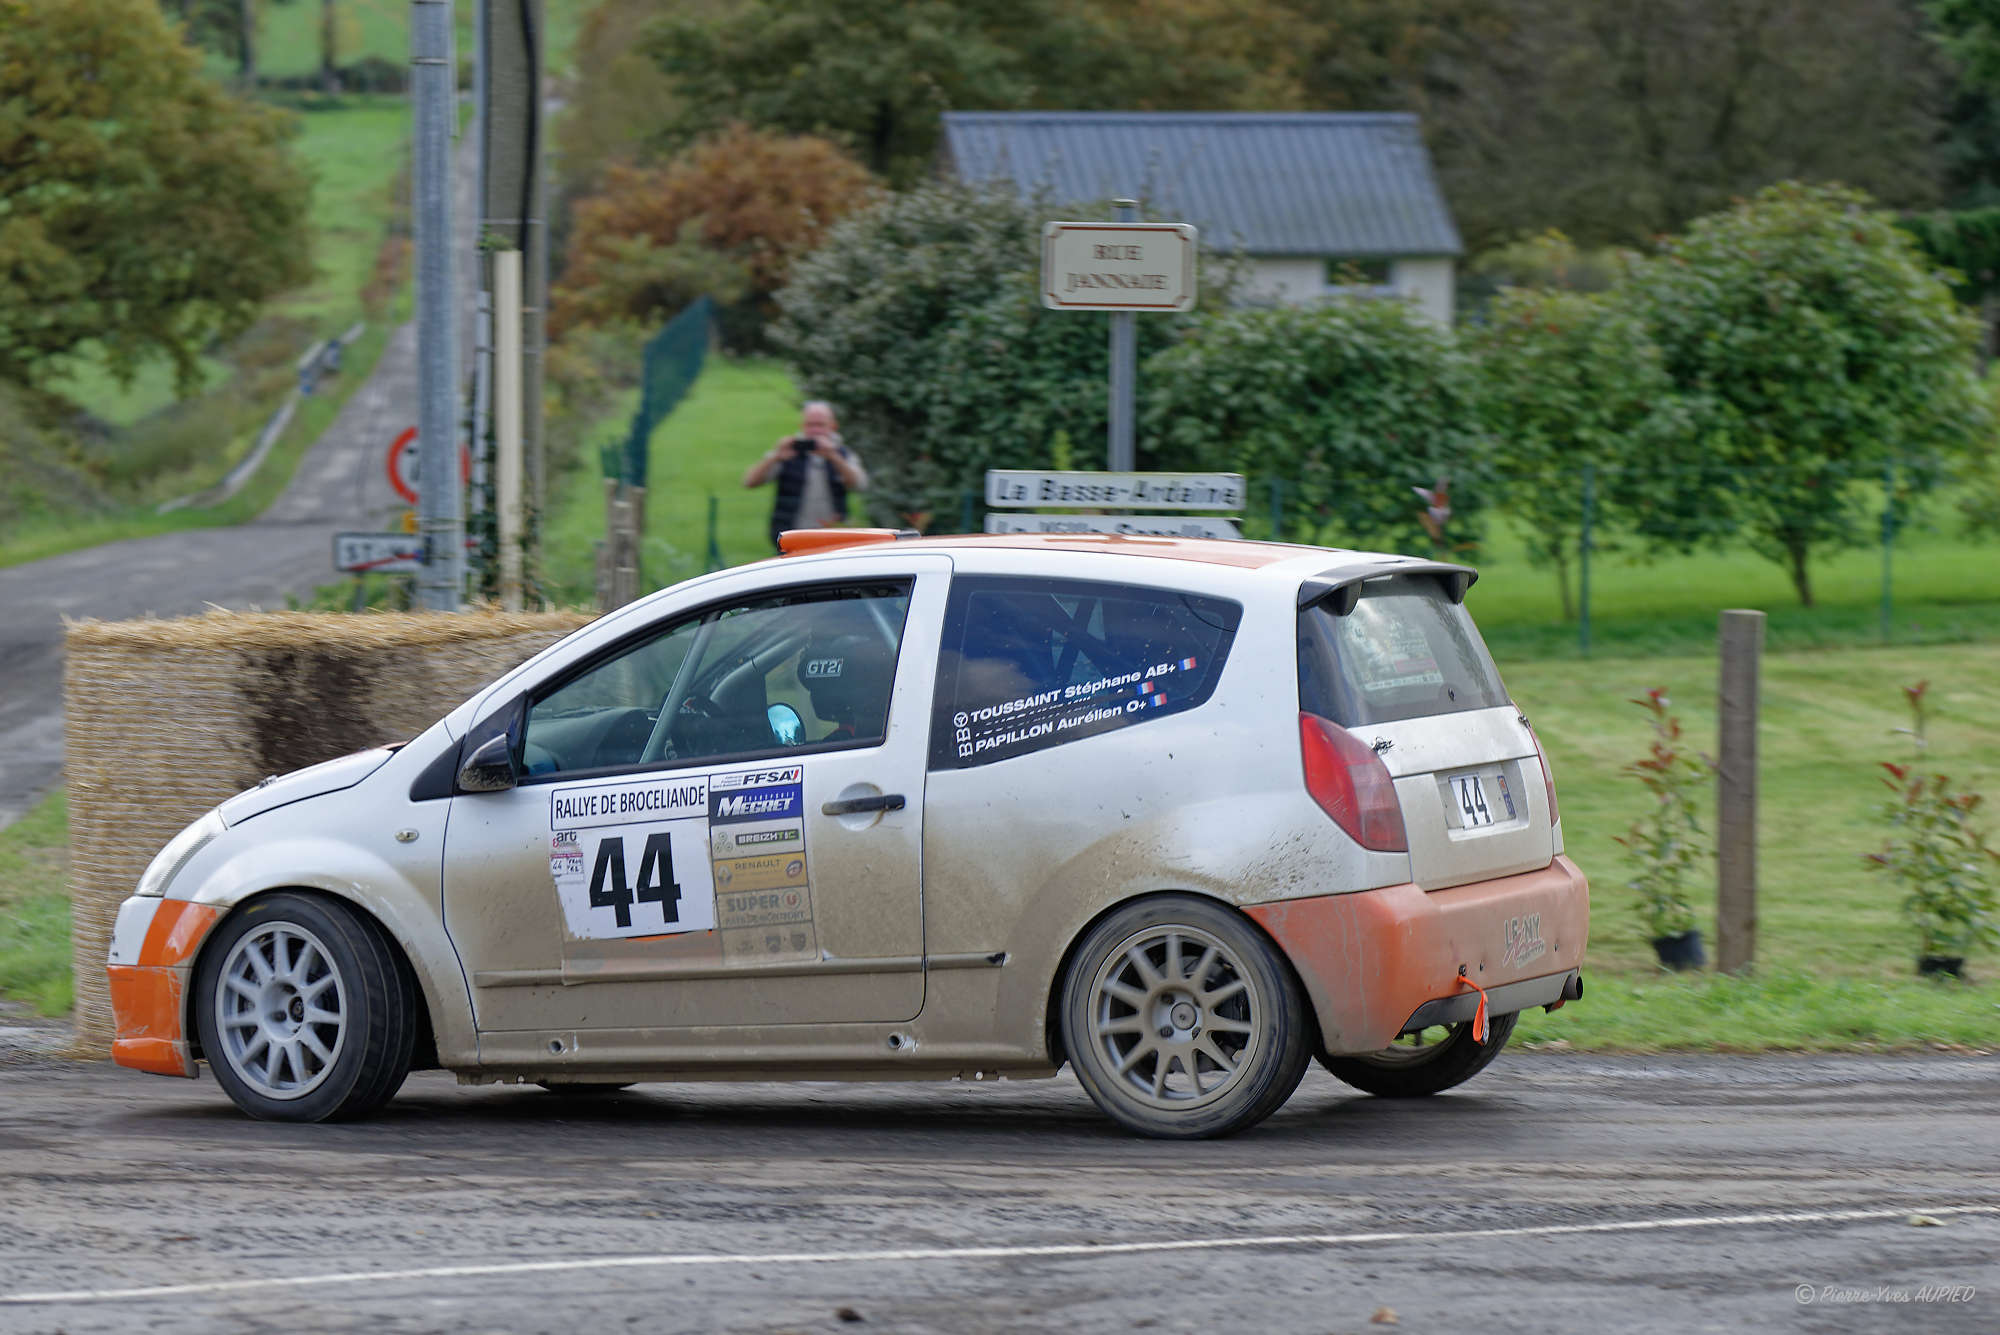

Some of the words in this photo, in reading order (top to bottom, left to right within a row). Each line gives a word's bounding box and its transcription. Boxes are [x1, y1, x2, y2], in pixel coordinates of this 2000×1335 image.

[1094, 244, 1144, 260] RUE
[997, 478, 1027, 501] La
[971, 688, 1061, 723] TOUSSAINT
[1064, 670, 1141, 700] Stéphane
[1144, 662, 1176, 680] AB+
[975, 720, 1053, 752] PAPILLON
[1056, 705, 1123, 731] Aurélien
[743, 770, 794, 785] FFSA
[555, 795, 598, 820] RALLYE
[601, 792, 617, 815] DE
[620, 785, 705, 813] BROCELIANDE
[1461, 776, 1491, 826] 44
[589, 832, 682, 928] 44
[727, 895, 780, 912] SUPER
